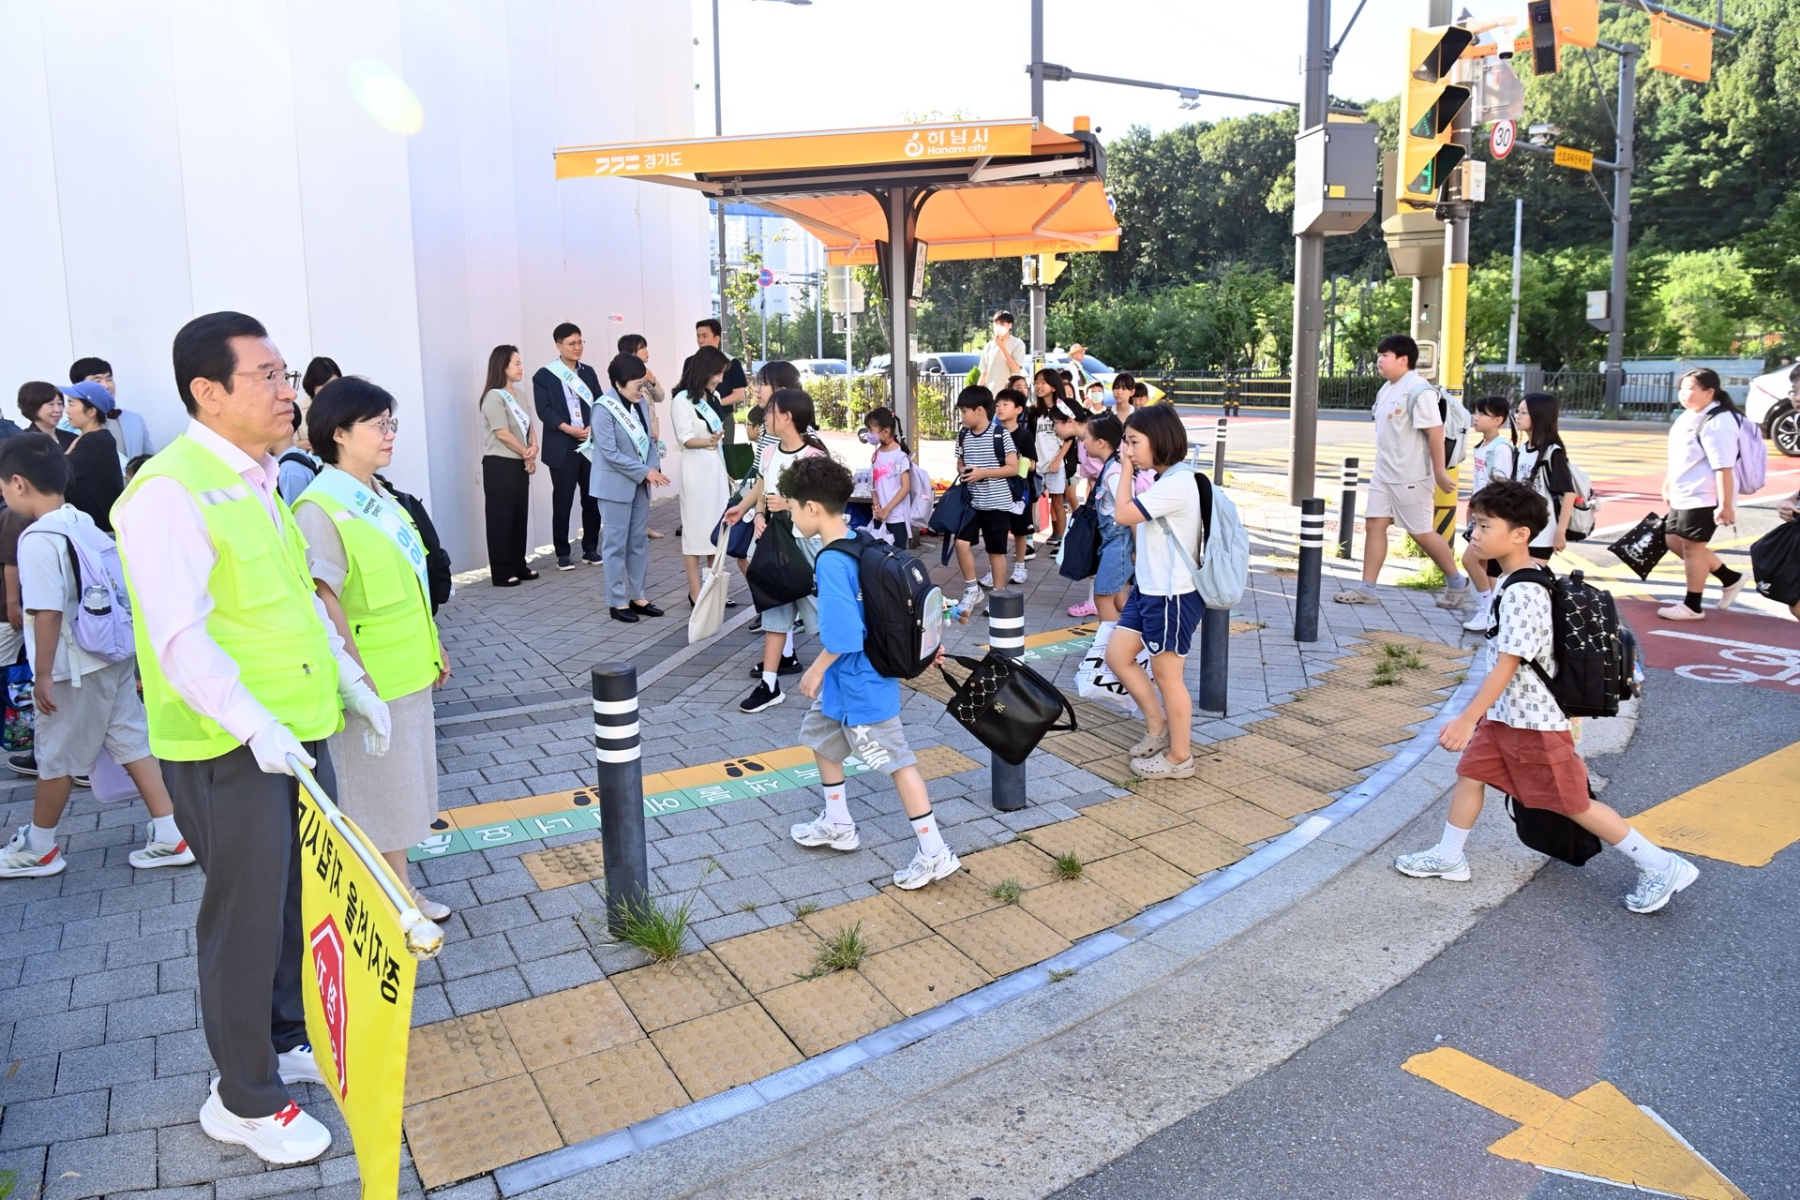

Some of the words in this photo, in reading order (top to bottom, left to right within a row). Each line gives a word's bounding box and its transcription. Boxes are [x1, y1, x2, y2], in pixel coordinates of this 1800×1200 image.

[926, 128, 989, 145] 하남시
[1495, 127, 1511, 147] 30
[926, 144, 964, 155] Hanam
[966, 142, 989, 155] city
[643, 151, 683, 169] 경기도
[858, 740, 891, 770] STAR
